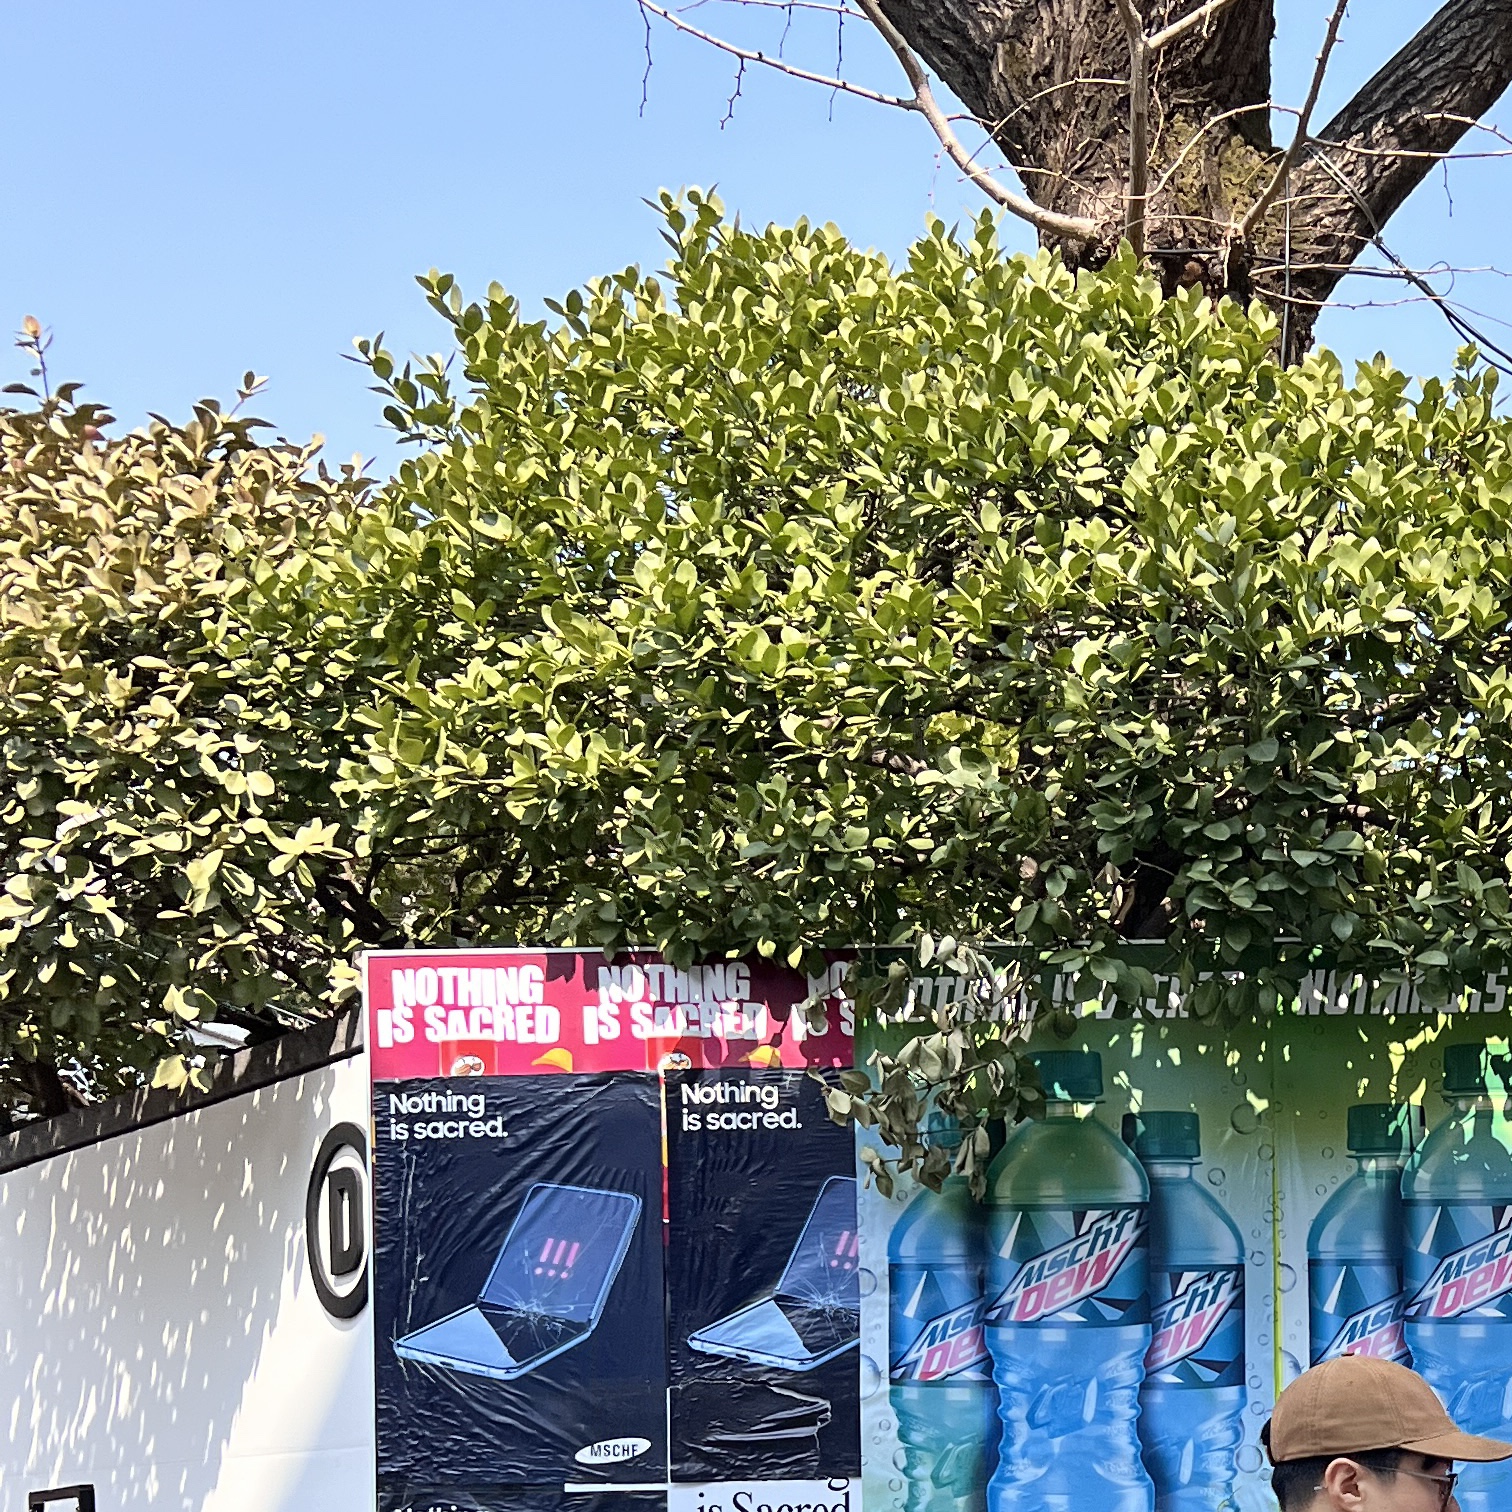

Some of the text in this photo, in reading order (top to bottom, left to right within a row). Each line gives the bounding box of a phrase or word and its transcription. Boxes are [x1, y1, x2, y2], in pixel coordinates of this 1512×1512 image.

[391, 965, 546, 1007] NOTHING
[598, 963, 751, 1004] NOTHING
[378, 1004, 561, 1049] IS SACRED
[583, 1002, 767, 1045] IS SACRED
[389, 1091, 485, 1116] Nothing
[681, 1082, 779, 1108] Nothing
[390, 1116, 508, 1140] is sacred.
[682, 1107, 802, 1131] is sacred.
[590, 1441, 639, 1458] MSCHF
